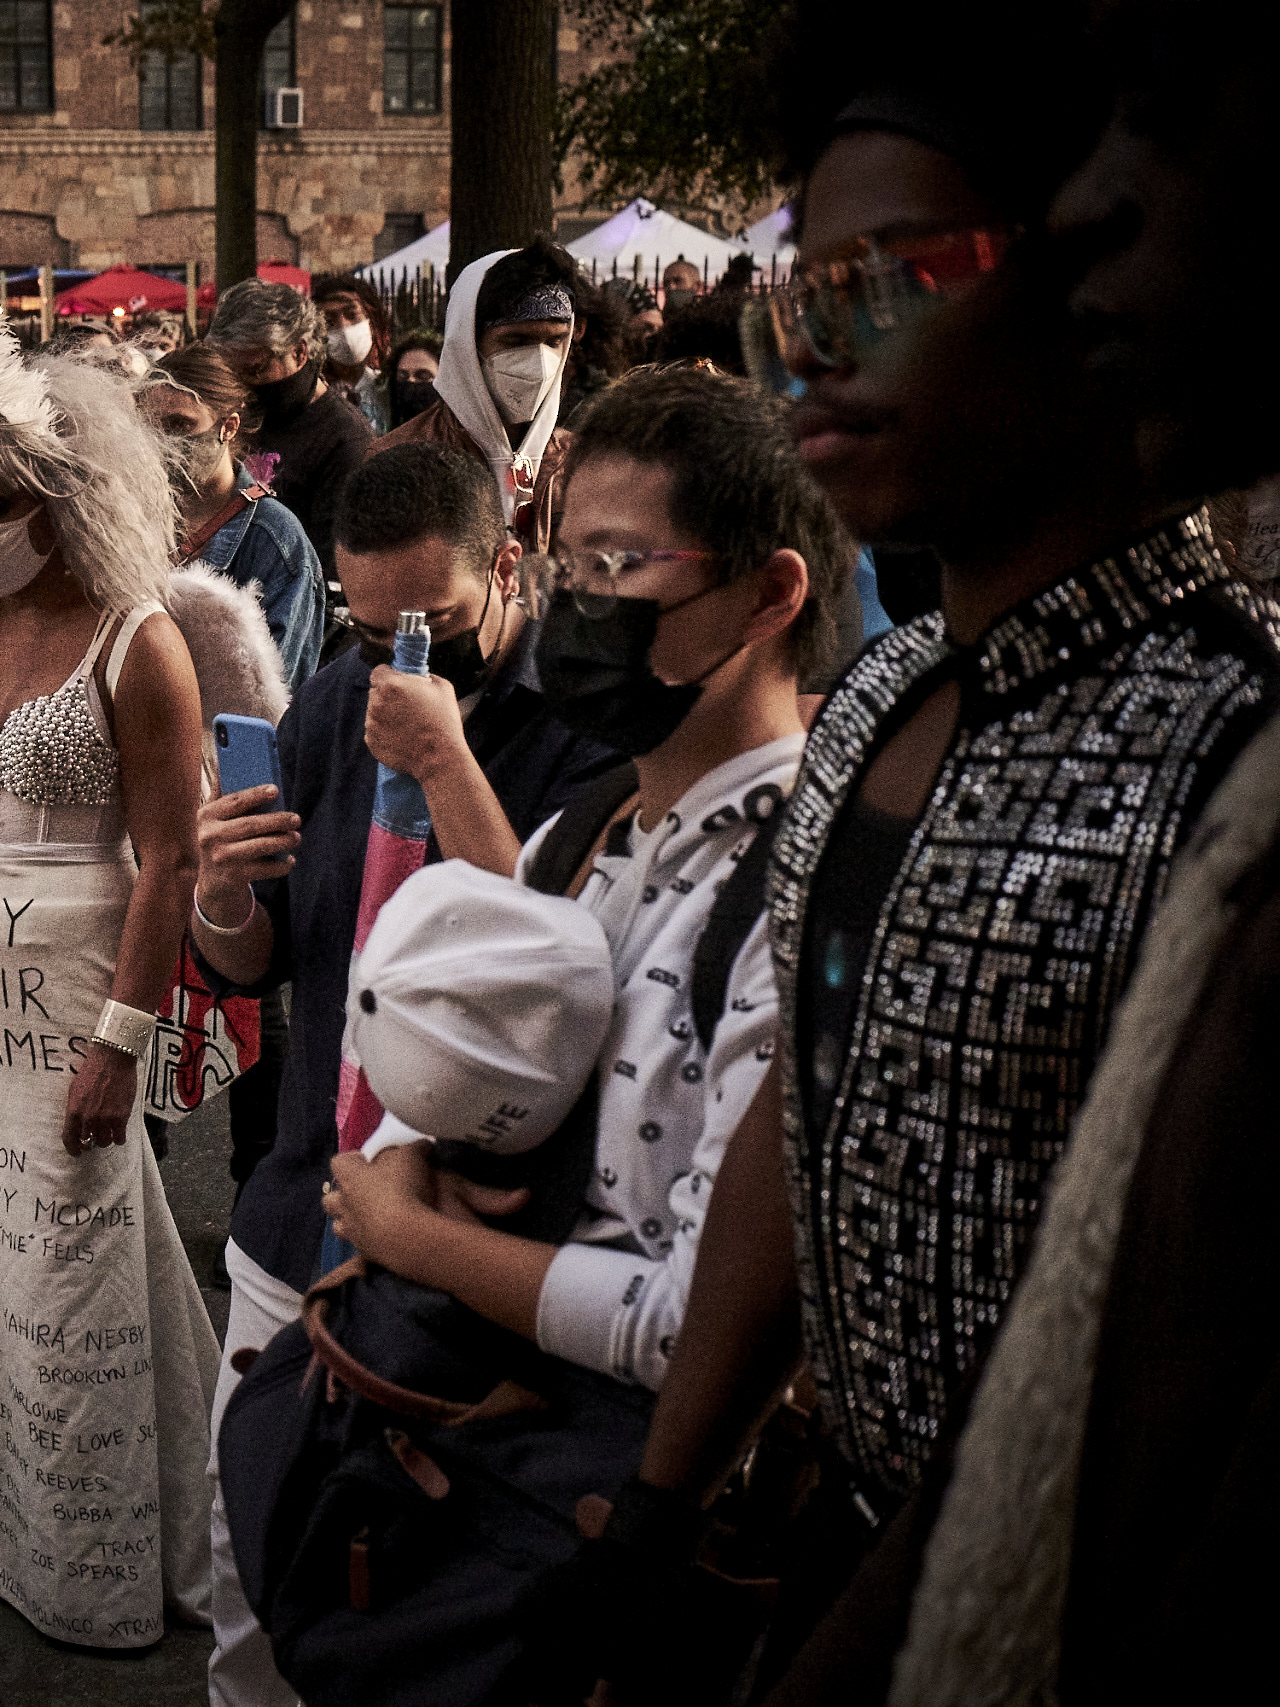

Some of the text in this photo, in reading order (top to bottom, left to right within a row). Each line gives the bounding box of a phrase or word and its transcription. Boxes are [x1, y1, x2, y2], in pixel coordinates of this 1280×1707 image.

[466, 1102, 528, 1145] LIFE
[35, 1197, 135, 1227] MCDADE
[43, 1238, 94, 1264] FELLS
[86, 1324, 146, 1354] NESBY
[38, 1365, 126, 1384] BROOKLYN
[29, 1421, 62, 1451] BEE
[77, 1429, 124, 1454] LOVE
[35, 1468, 108, 1492] REEVES
[53, 1503, 113, 1523] BUBBA
[97, 1536, 155, 1557] TRACY
[31, 1549, 139, 1582] ZOE SPEARS
[32, 1600, 92, 1634] POLANCO
